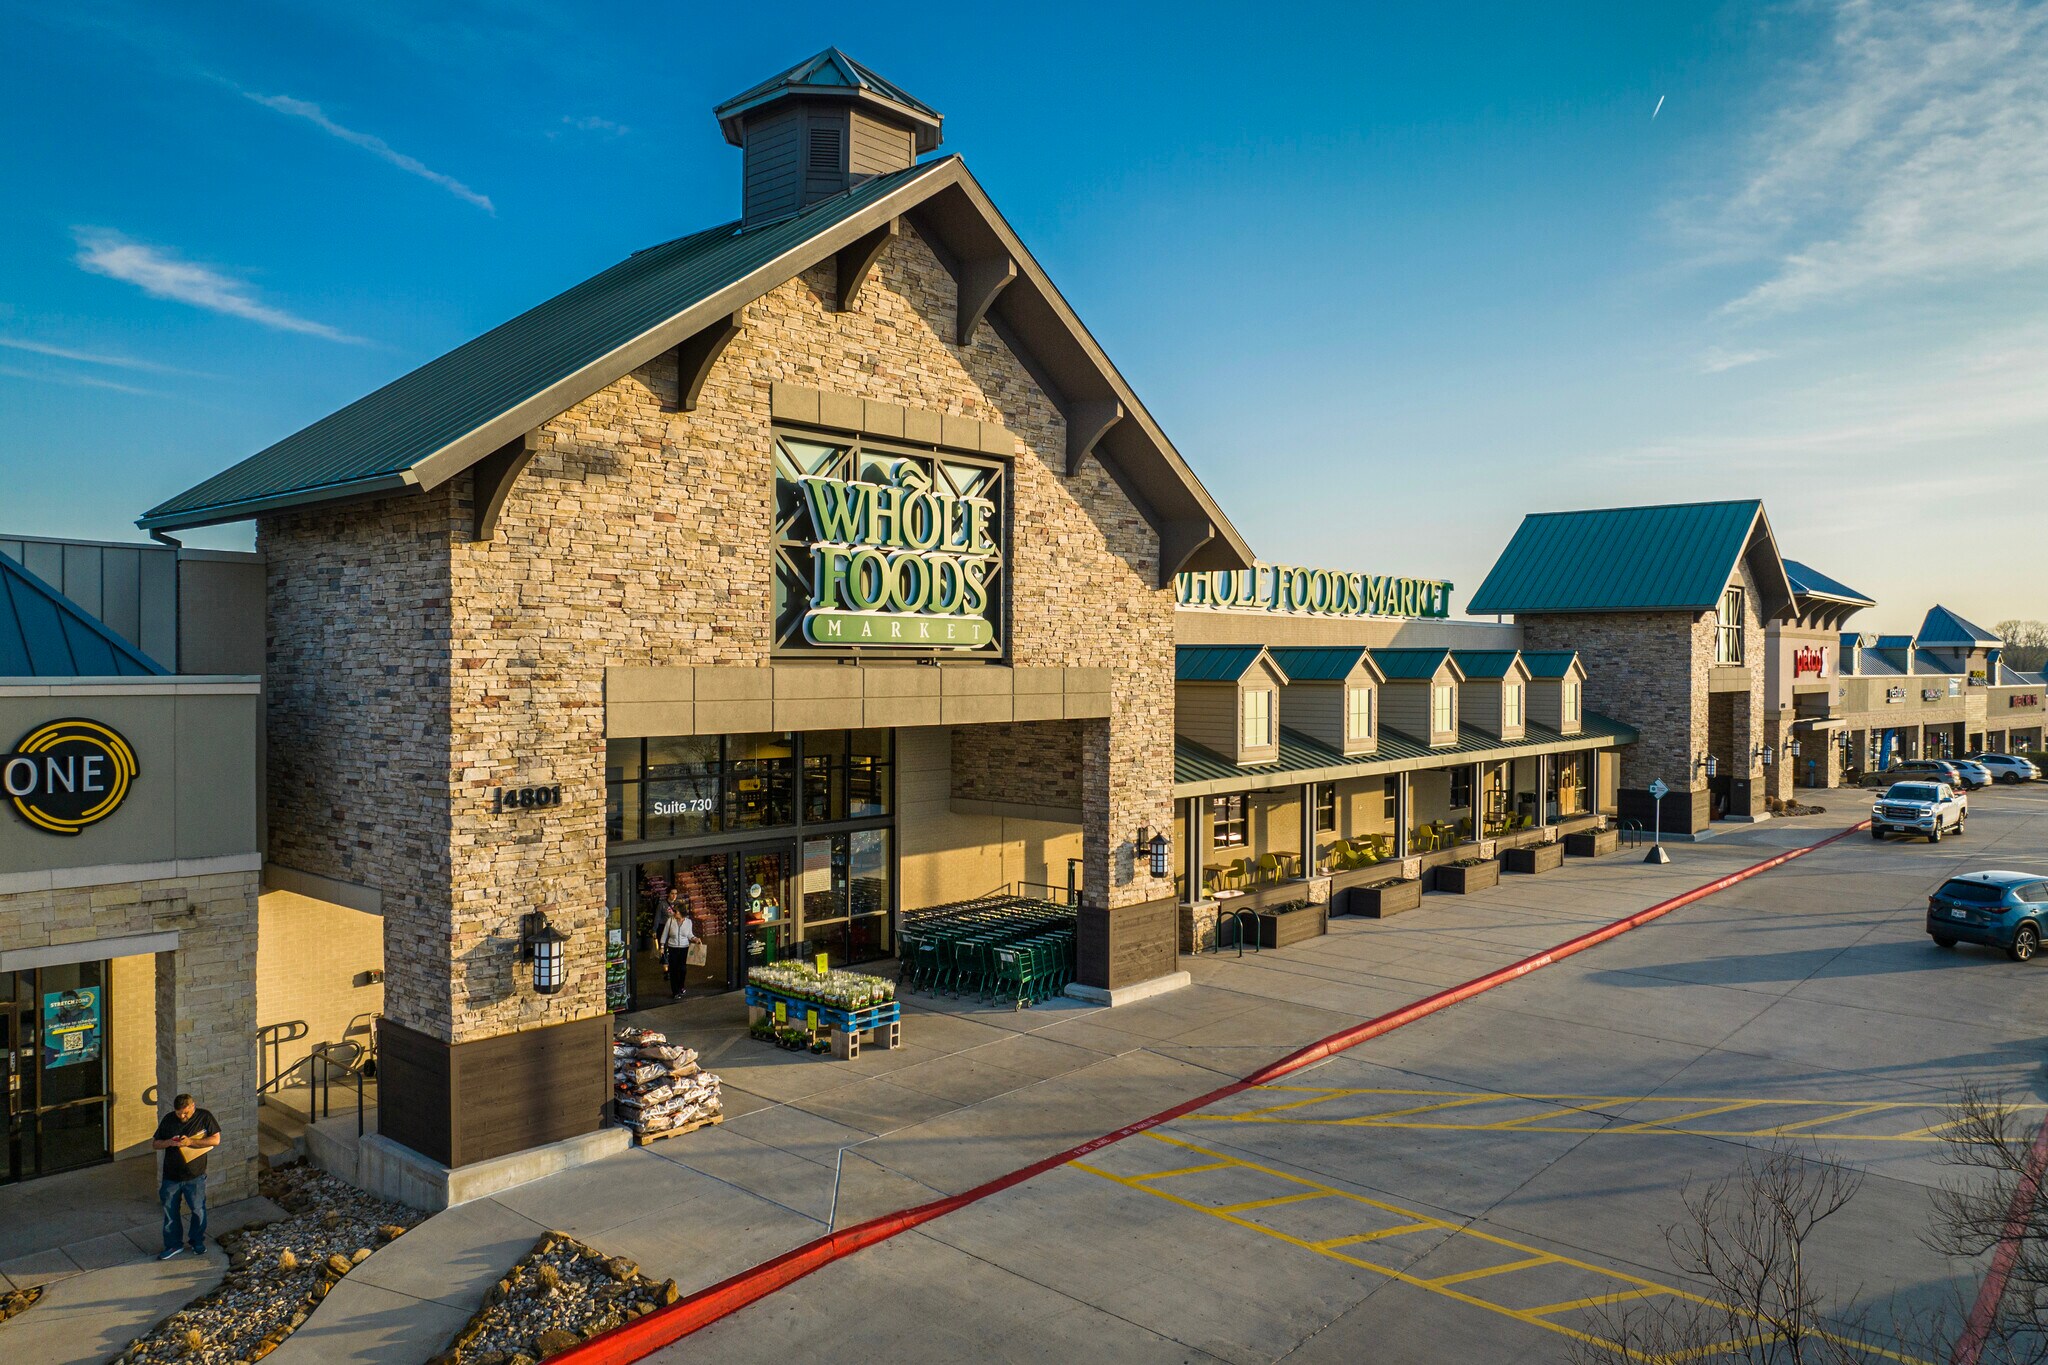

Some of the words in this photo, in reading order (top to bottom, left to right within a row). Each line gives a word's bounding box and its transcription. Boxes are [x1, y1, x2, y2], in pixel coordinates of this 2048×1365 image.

[799, 462, 996, 555] WHOLE
[811, 544, 987, 615] FOODS
[1272, 565, 1361, 614] FOODS
[1364, 574, 1454, 618] MARKET
[827, 619, 982, 641] MARKET
[1794, 646, 1821, 678] petco
[503, 786, 561, 809] 4801
[654, 801, 687, 816] Suite
[690, 798, 713, 813] 730
[50, 1000, 75, 1008] STRETCH
